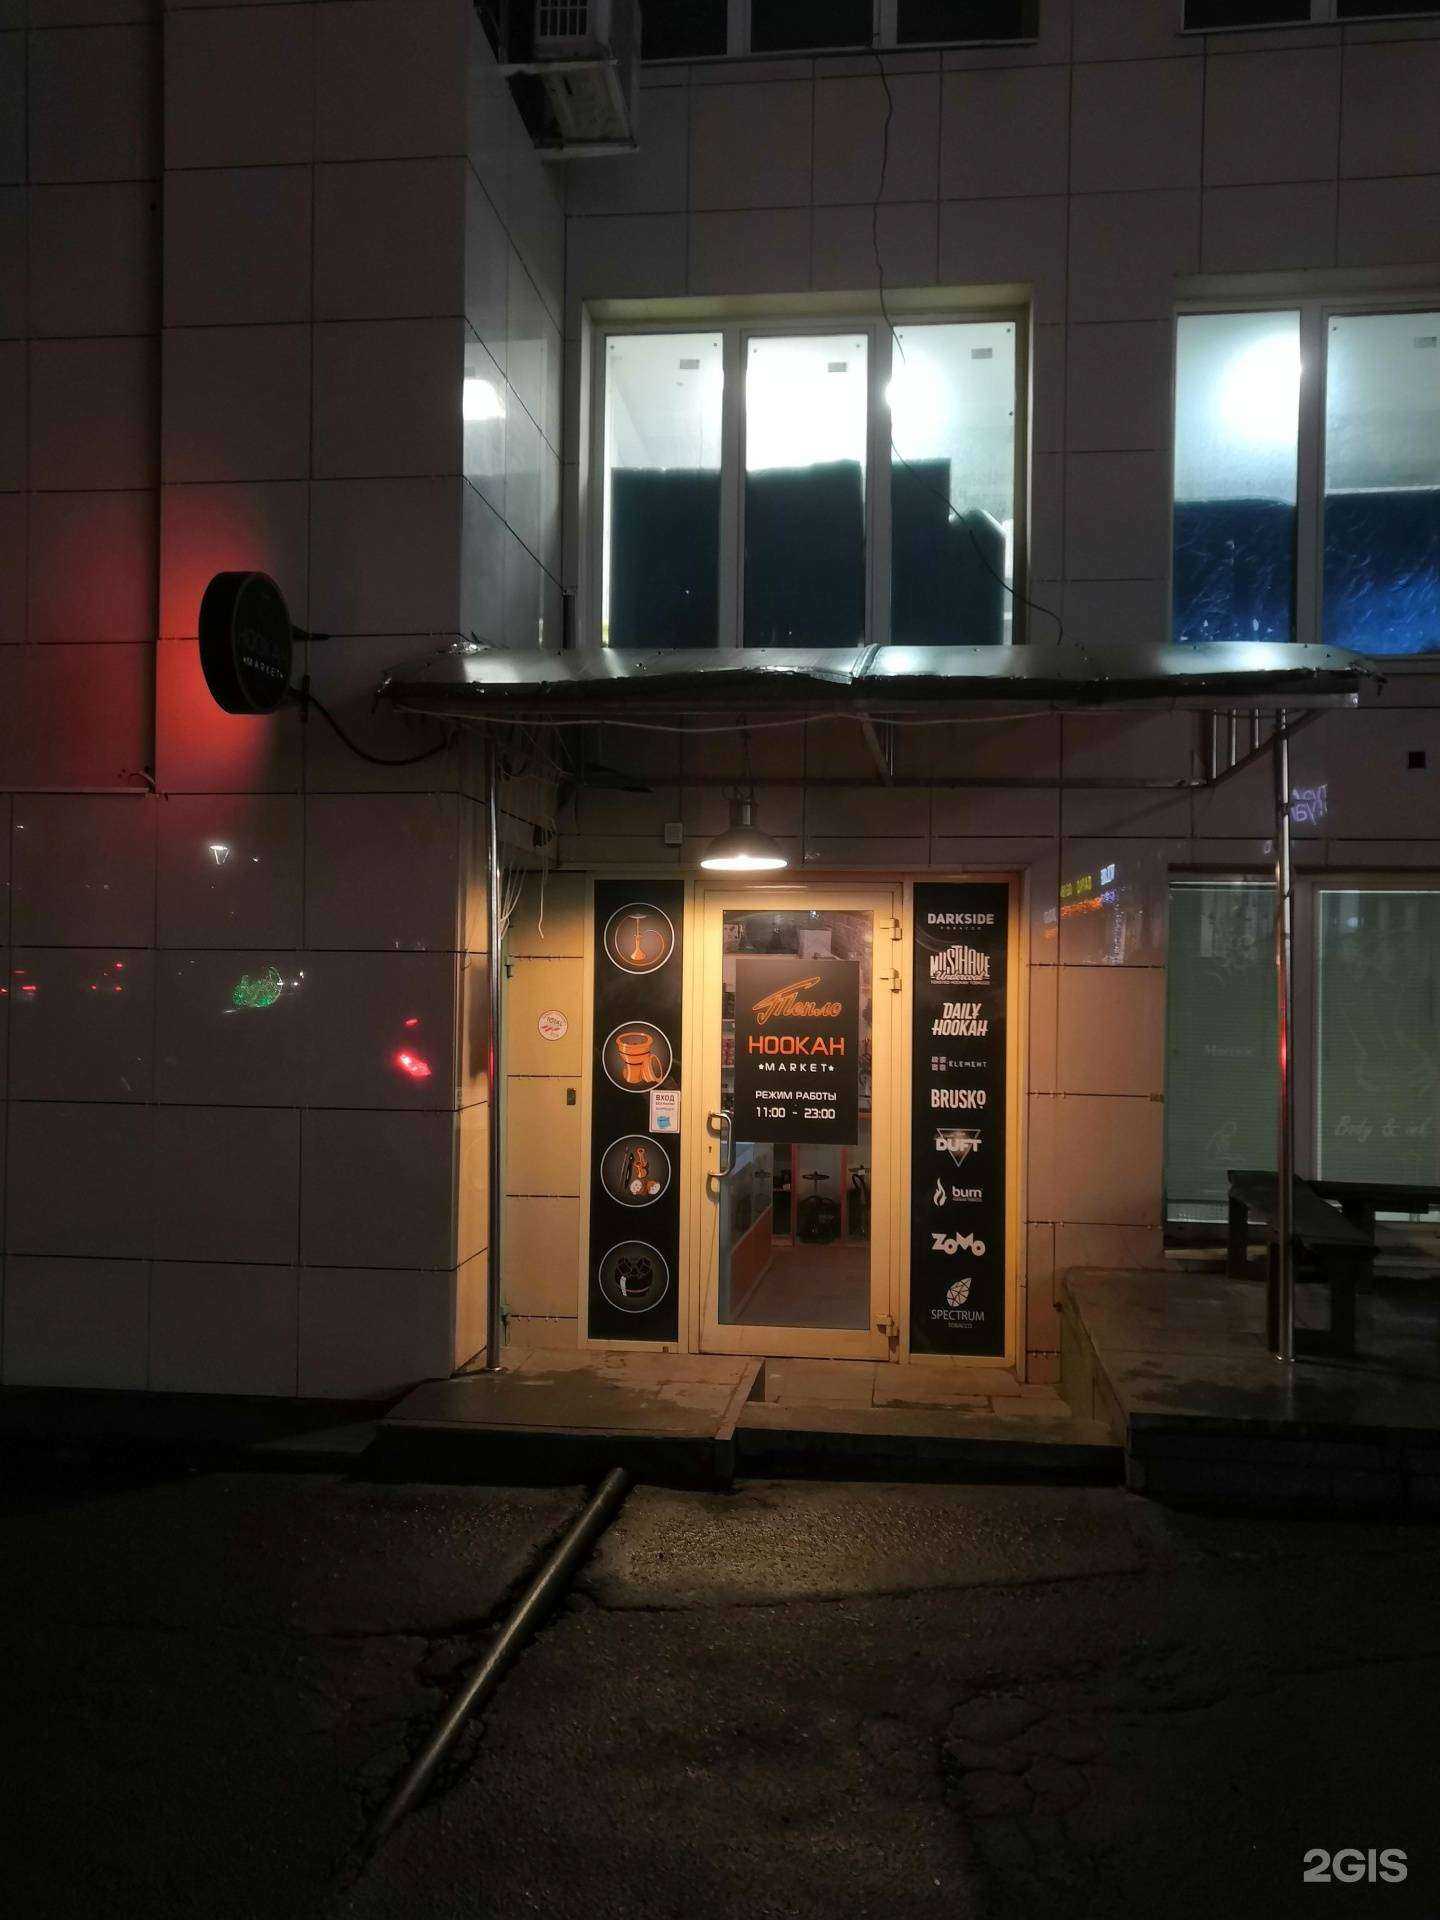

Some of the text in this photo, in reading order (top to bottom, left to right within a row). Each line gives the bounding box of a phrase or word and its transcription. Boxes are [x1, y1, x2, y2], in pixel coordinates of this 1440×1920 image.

[928, 913, 994, 925] DARKSIDE
[942, 1002, 982, 1020] DAILY
[931, 1019, 989, 1037] HOOKAH
[748, 1035, 845, 1056] HOOKAH
[765, 1063, 828, 1073] MARKET
[948, 1060, 988, 1068] ELEMENT
[655, 1094, 675, 1102] ВХОД
[755, 1090, 837, 1101] РЕЖИМ РАБОТЫ
[931, 1089, 987, 1109] BRUSKO
[756, 1106, 786, 1118] 11:00
[804, 1107, 836, 1119] 23:00
[935, 1138, 982, 1152] DUFT
[931, 1308, 985, 1321] SPECTRUM
